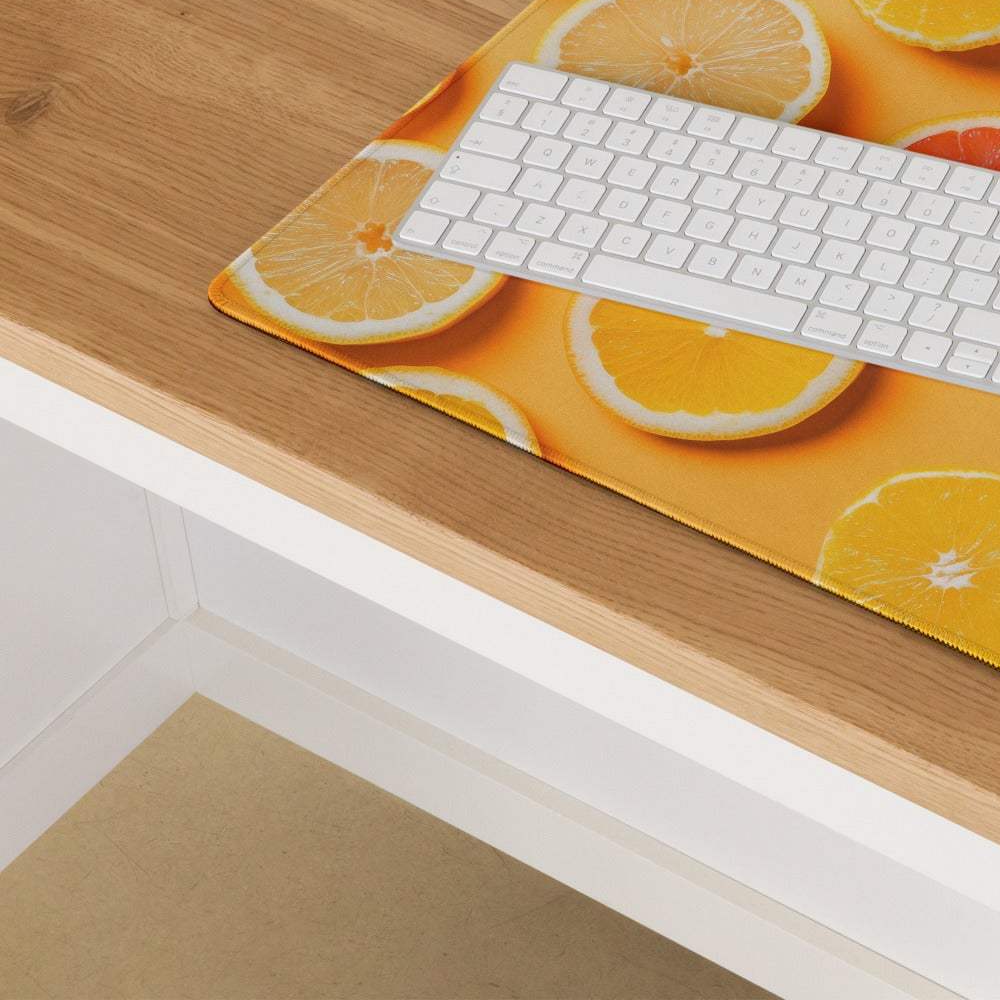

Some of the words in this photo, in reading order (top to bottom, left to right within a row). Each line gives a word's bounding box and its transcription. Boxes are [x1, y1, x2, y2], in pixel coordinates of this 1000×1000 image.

[542, 148, 553, 157] Q
[584, 157, 598, 167] W
[669, 177, 680, 187] R
[758, 198, 766, 207] Y
[799, 207, 810, 217] U
[886, 229, 897, 238] O
[930, 239, 940, 247] P
[580, 128, 590, 137] 2
[621, 138, 632, 147] 3
[707, 158, 717, 166] 5
[922, 208, 932, 217] 0
[535, 215, 546, 225] Z
[577, 225, 589, 235] X
[621, 236, 632, 245] C
[666, 246, 676, 255] V
[707, 256, 718, 266] B
[751, 267, 762, 277] N
[794, 277, 807, 287] M
[618, 200, 629, 209] D
[662, 210, 672, 219] F
[748, 231, 760, 240] H
[791, 241, 801, 250] J
